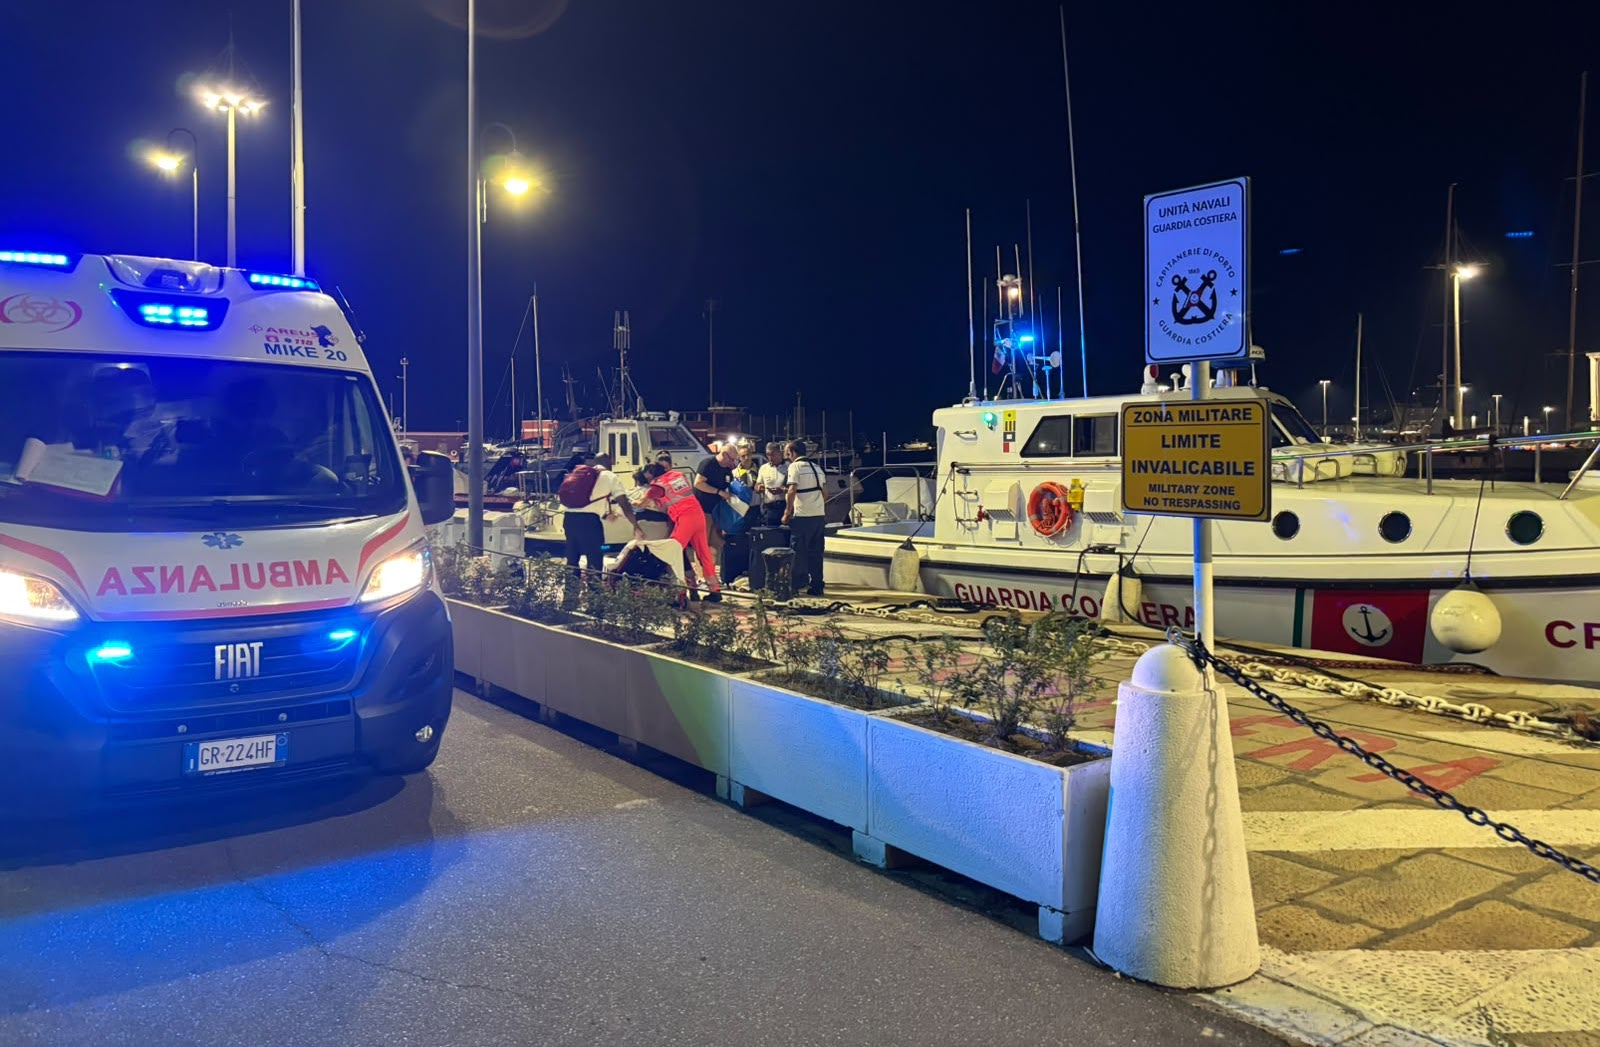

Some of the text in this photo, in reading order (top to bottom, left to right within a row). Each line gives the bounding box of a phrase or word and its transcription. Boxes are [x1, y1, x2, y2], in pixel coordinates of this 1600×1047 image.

[1158, 196, 1231, 218] UNITÀ NAVALI
[1152, 211, 1237, 234] GUARDIA COSTIERA
[1156, 247, 1235, 288] CAPITANERIE DI PORTO
[1159, 312, 1233, 345] GUARDIA COSTIERA
[264, 343, 347, 362] MIKE 20
[1133, 408, 1252, 423] ZONA MILITARE
[1161, 434, 1221, 448] LIMITE
[1132, 460, 1255, 476] INVALICABILE
[1148, 484, 1235, 496] MILITARY ZONE
[1143, 497, 1240, 510] NO TRESPASSING
[954, 583, 1196, 628] GUARDIA COERA
[214, 642, 263, 680] FIAT
